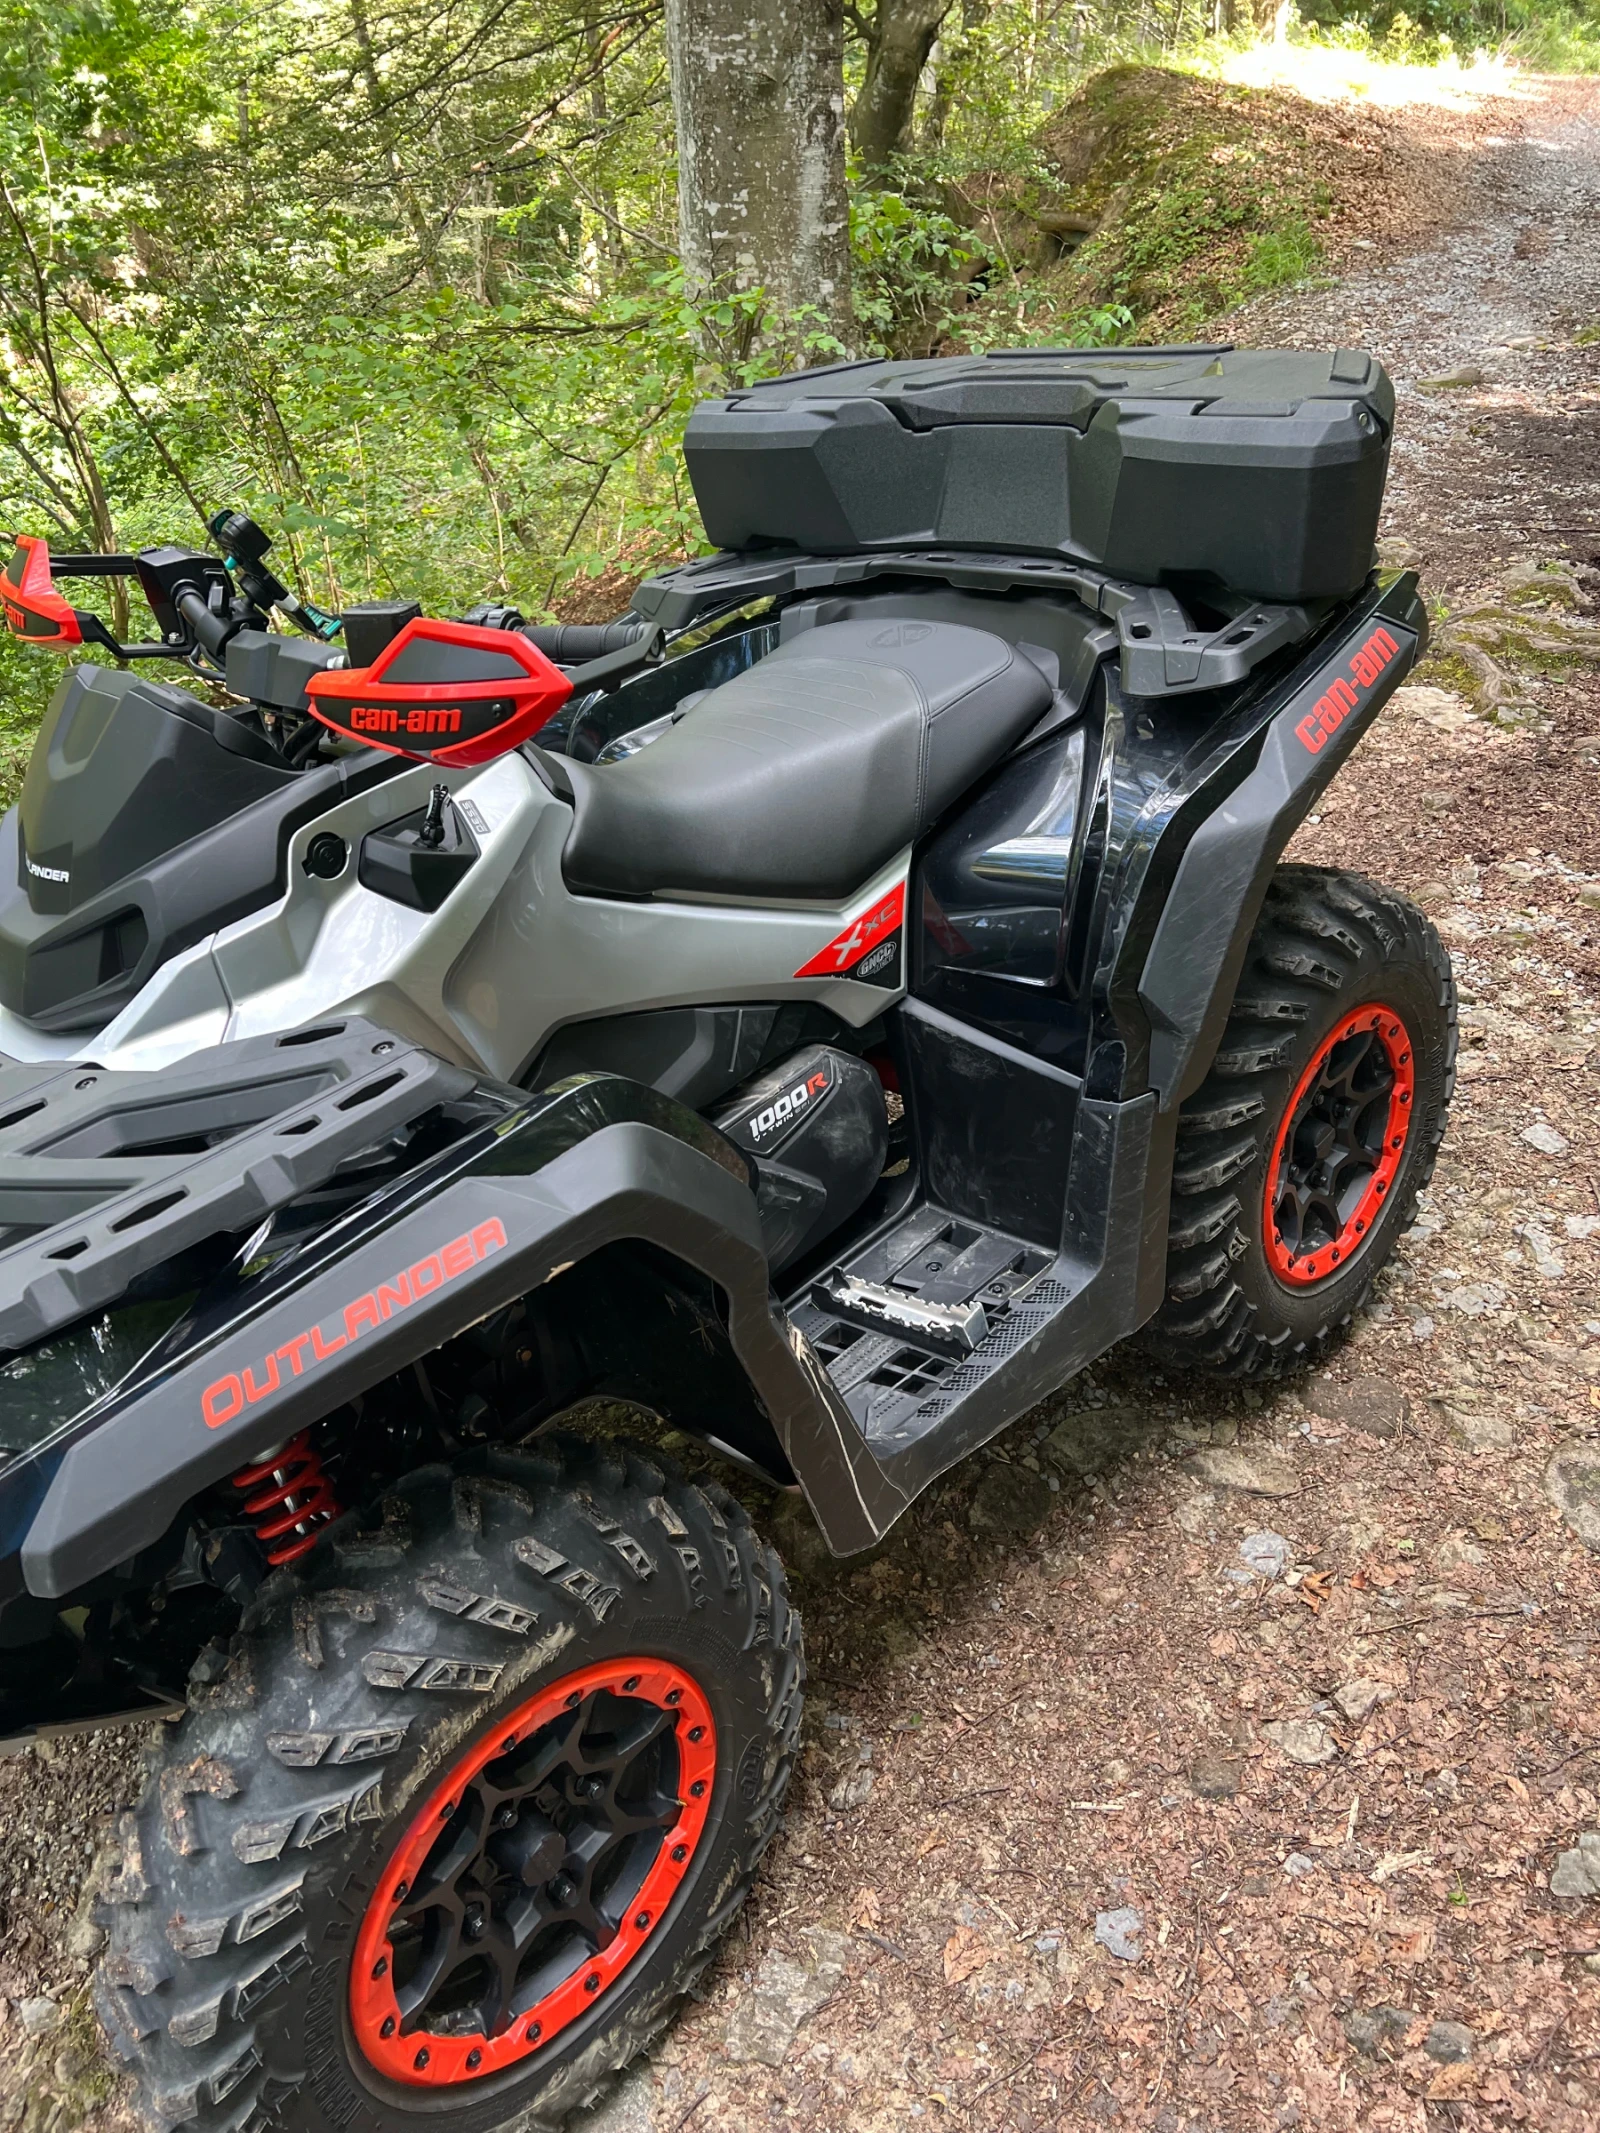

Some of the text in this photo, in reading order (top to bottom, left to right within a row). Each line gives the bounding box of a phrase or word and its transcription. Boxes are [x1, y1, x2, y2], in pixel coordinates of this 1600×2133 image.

[350, 707, 462, 733] can-am
[1294, 626, 1400, 755] can-am
[860, 943, 896, 976] GNCC
[749, 1071, 828, 1138] 1000R
[201, 1216, 508, 1430] OUTLANDER
[304, 1955, 342, 2064] CROSS
